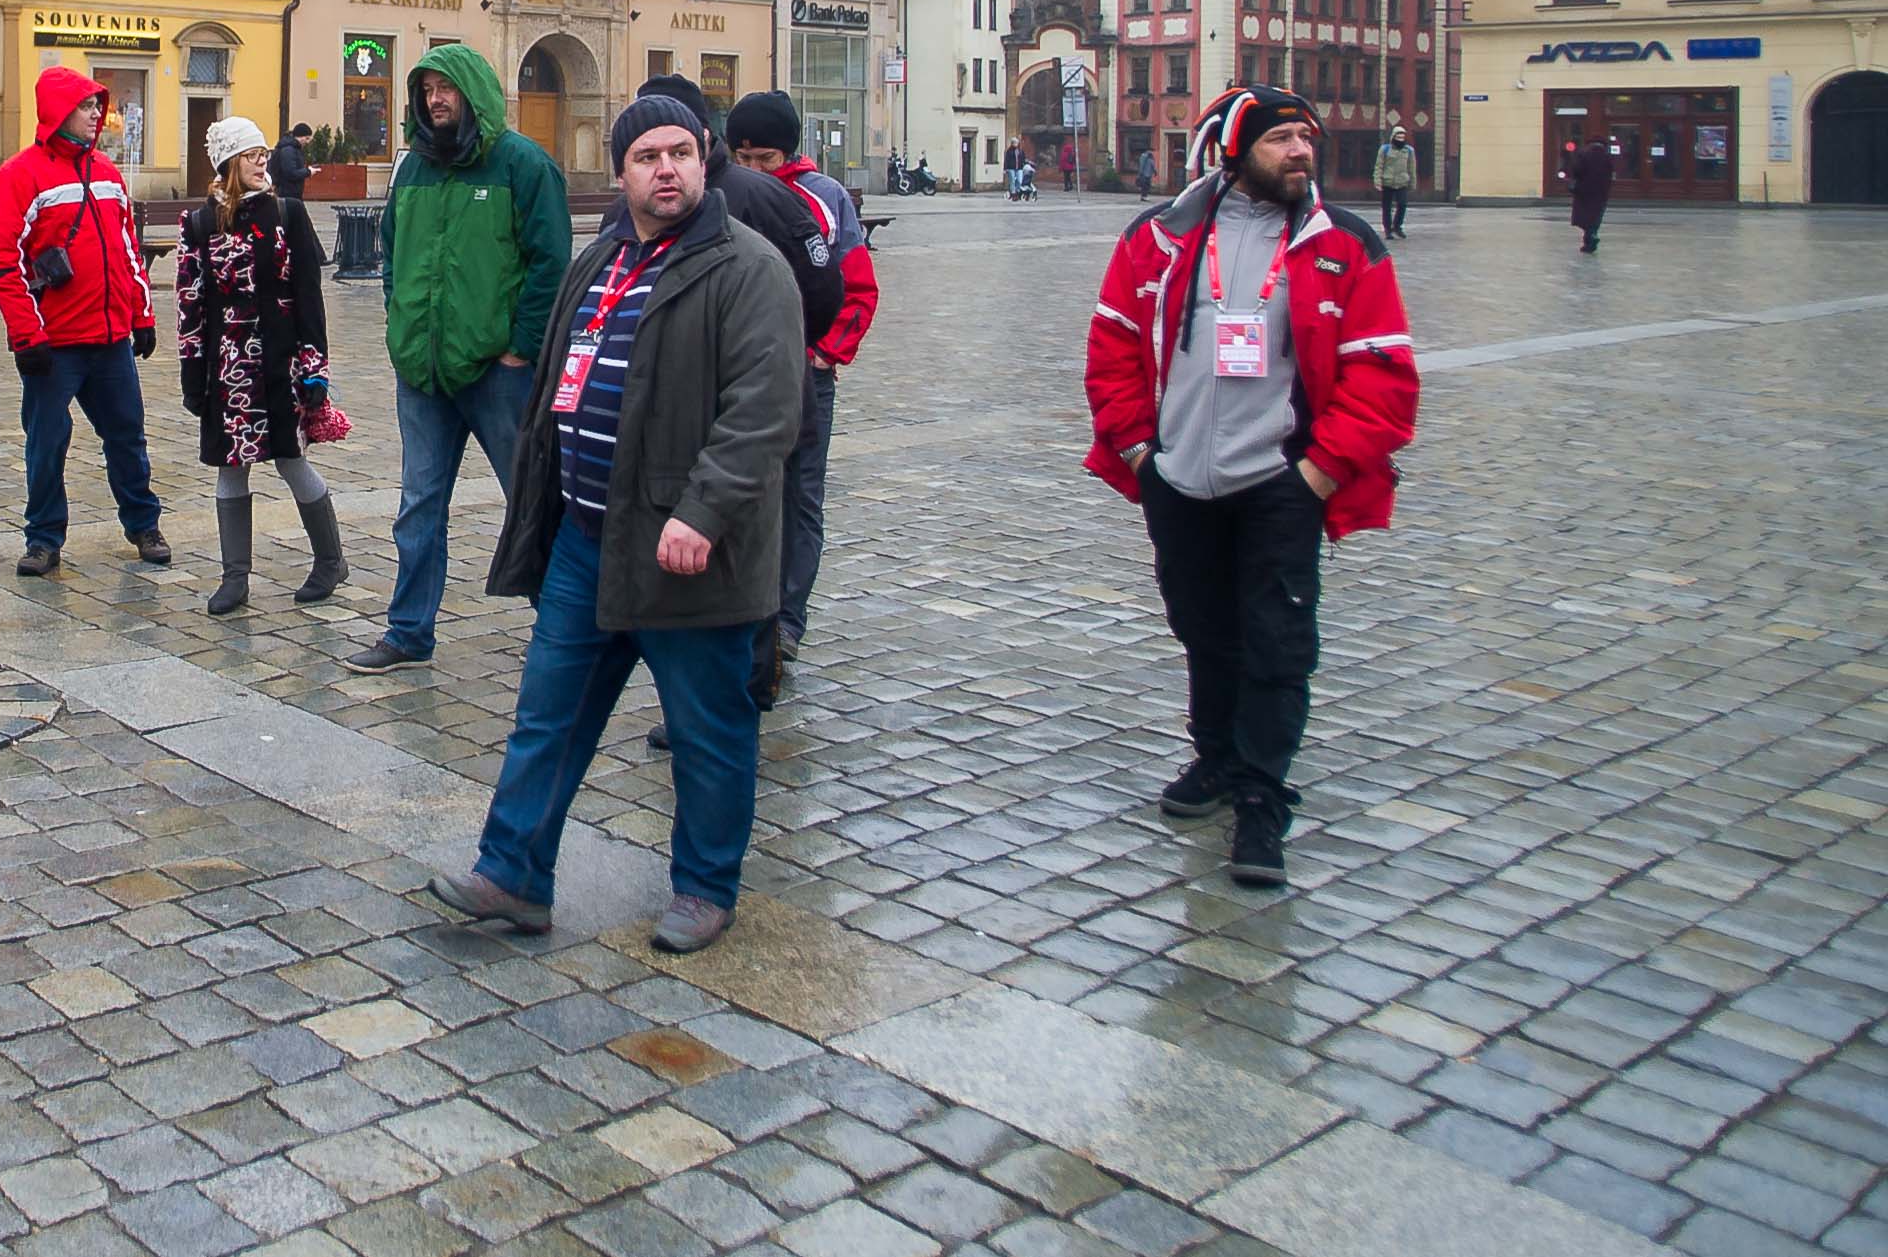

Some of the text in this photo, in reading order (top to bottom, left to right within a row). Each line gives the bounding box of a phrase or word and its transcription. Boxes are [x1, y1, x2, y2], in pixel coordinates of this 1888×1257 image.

[34, 11, 160, 32] SOUVENIRS
[670, 11, 726, 33] ANTYKI
[809, 2, 869, 25] Bank Pekao
[1526, 40, 1674, 64] JAZZDA
